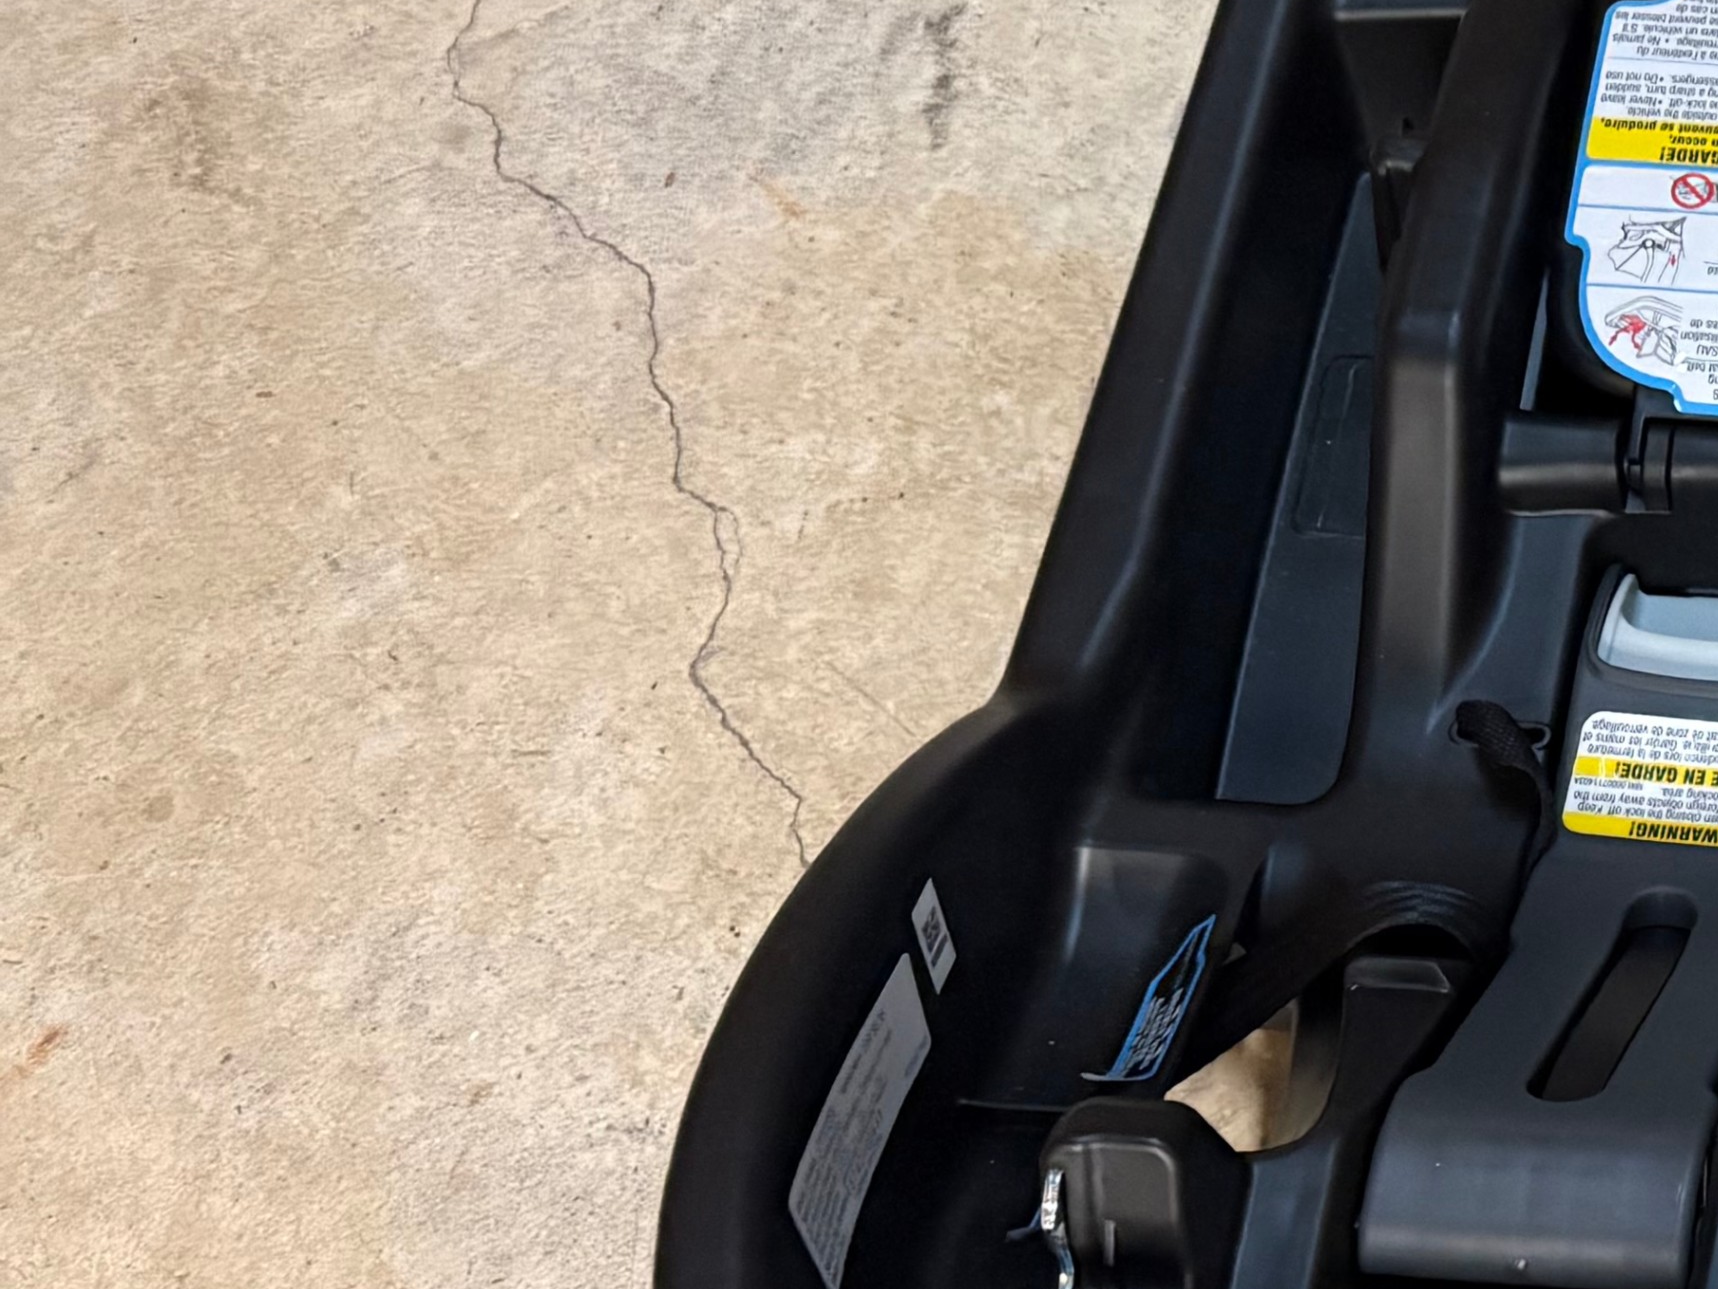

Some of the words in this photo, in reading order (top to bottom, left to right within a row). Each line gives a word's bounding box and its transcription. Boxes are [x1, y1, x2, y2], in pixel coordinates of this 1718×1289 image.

[1613, 760, 1678, 784] GARDE!
[1682, 767, 1706, 785] EN
[1629, 821, 1718, 842] WARNING!
